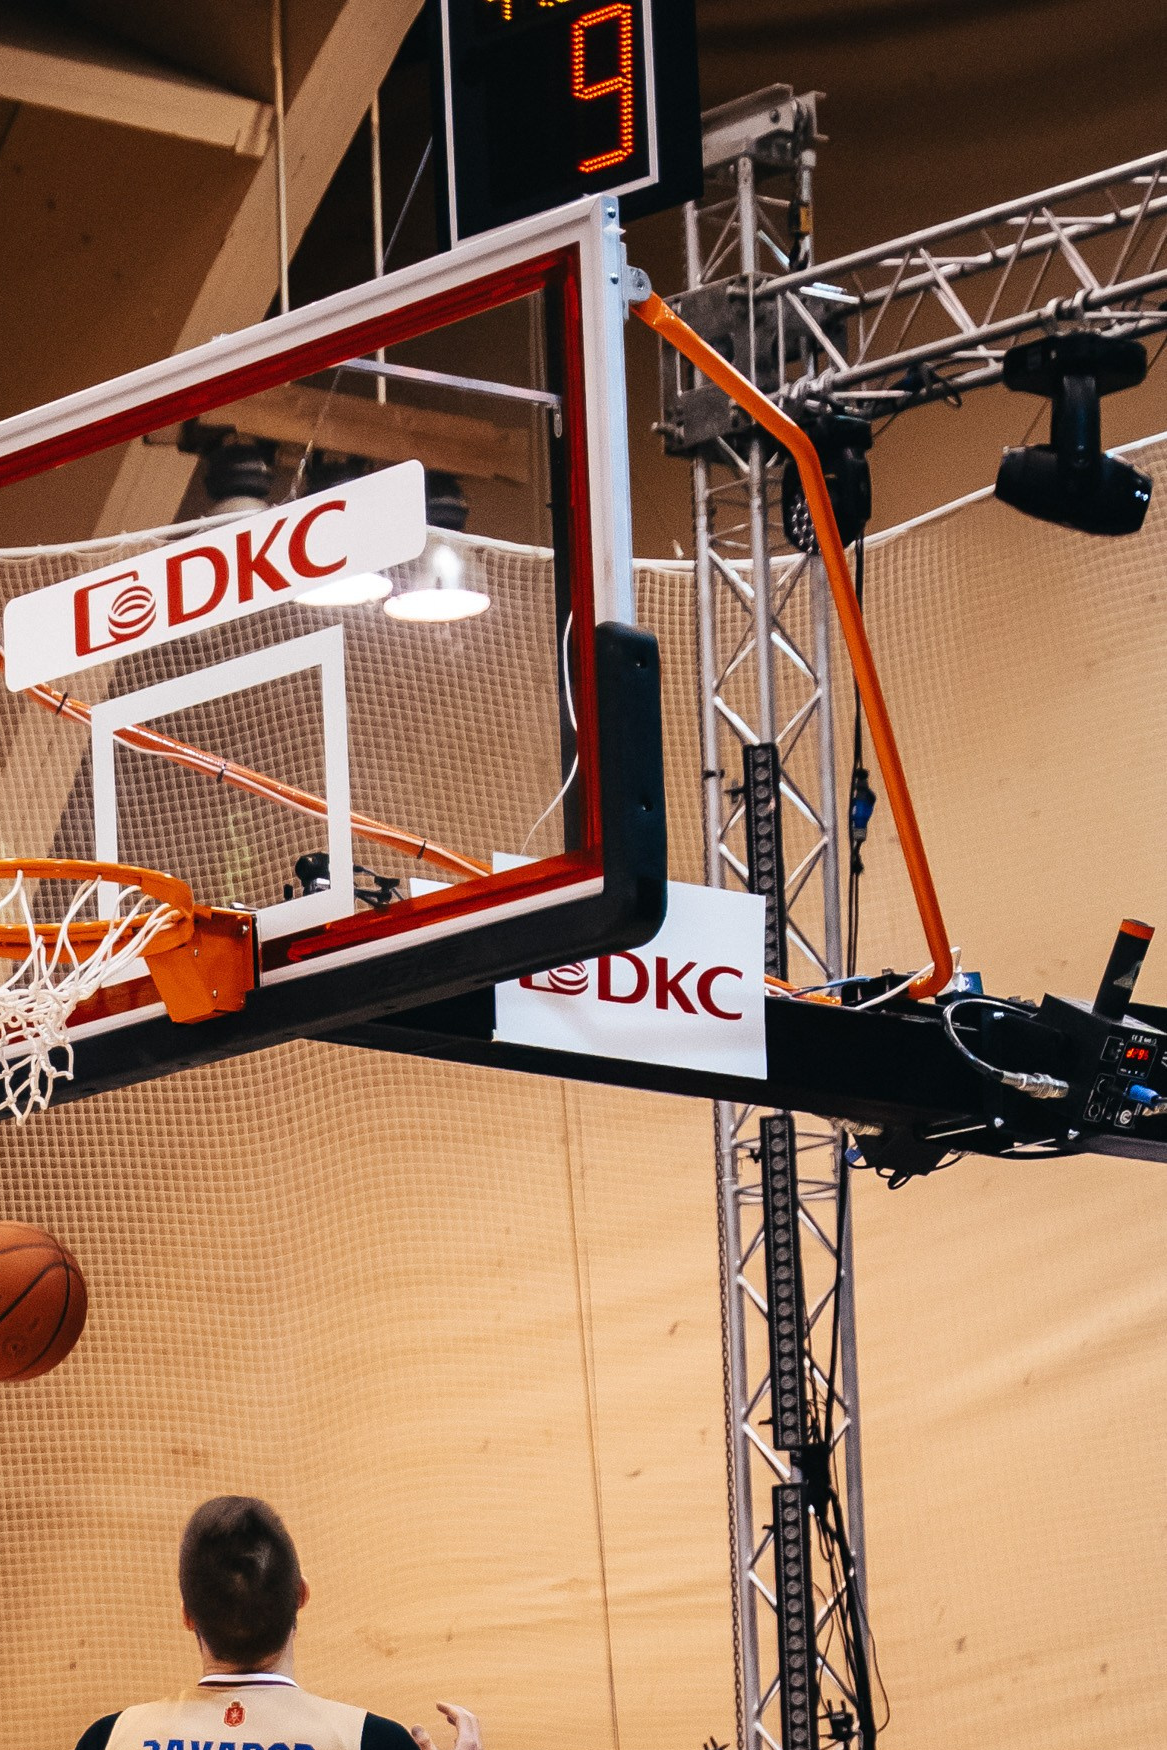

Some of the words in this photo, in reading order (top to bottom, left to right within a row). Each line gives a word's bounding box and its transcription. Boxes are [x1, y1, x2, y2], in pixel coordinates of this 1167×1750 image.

[571, 3, 633, 173] 9
[165, 499, 348, 628] DKC
[597, 951, 743, 1020] DKC
